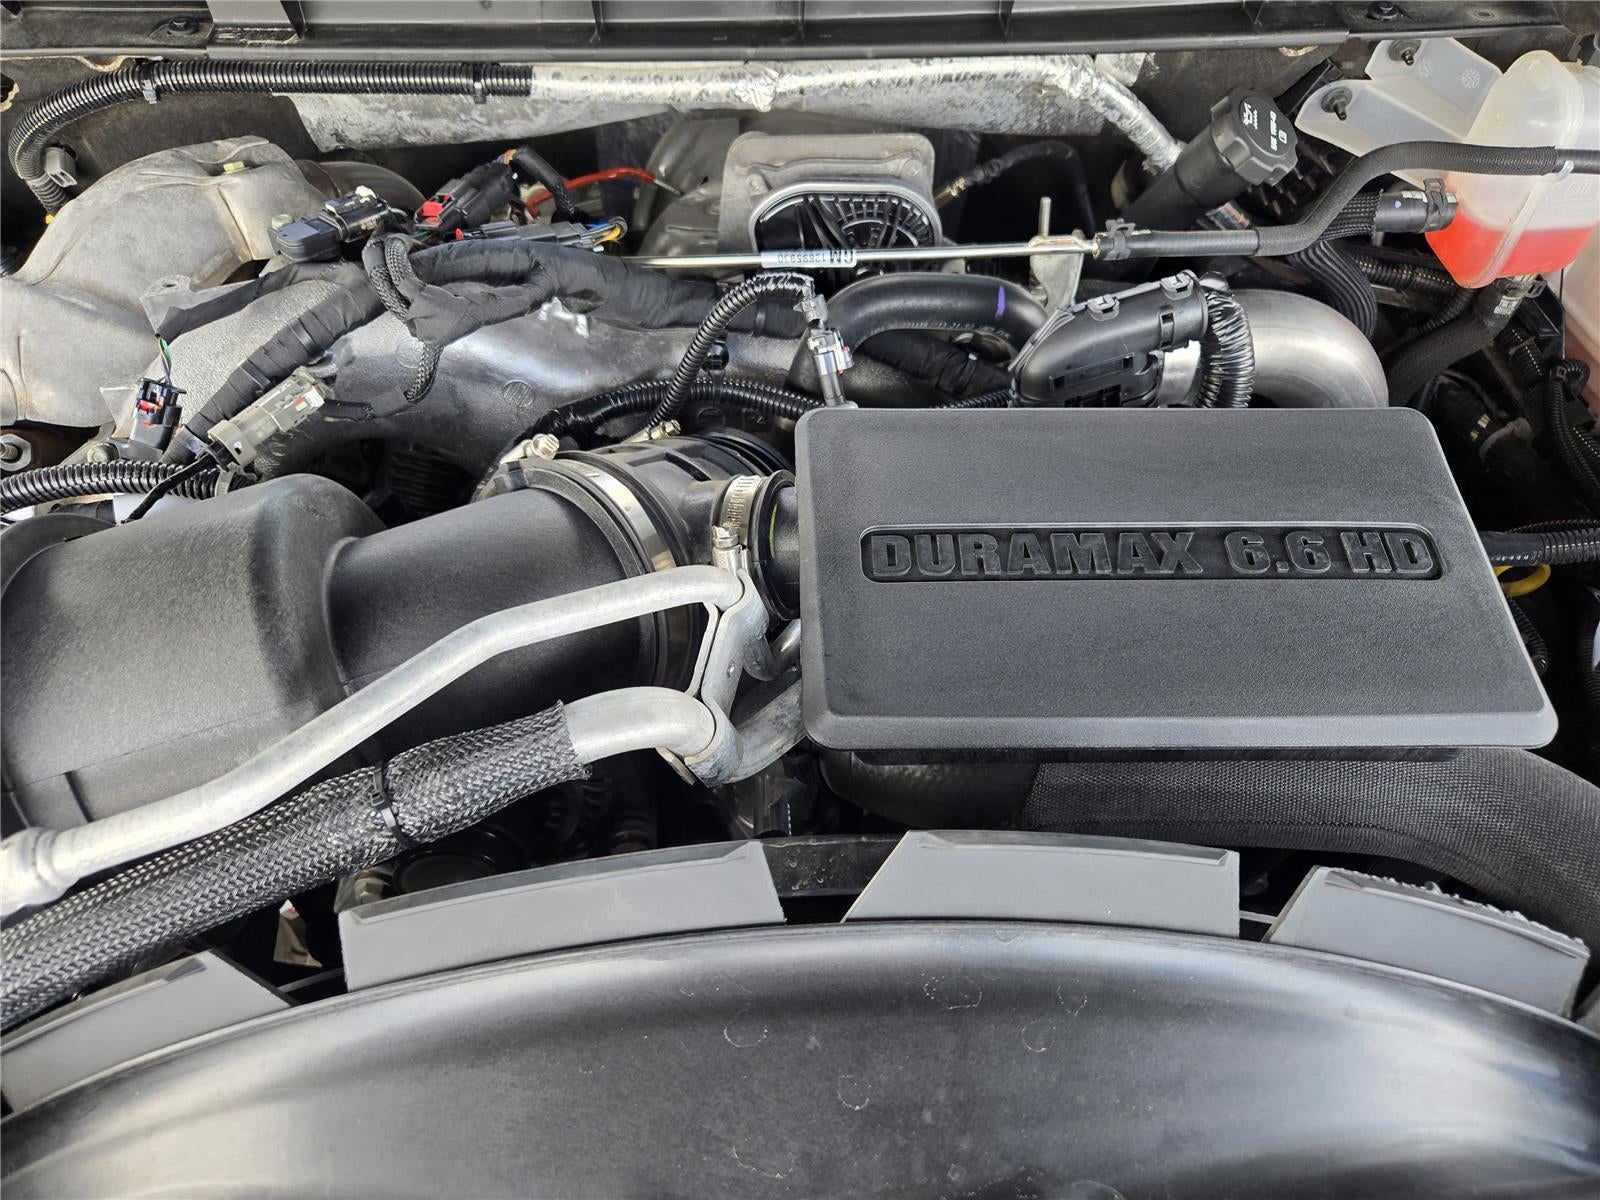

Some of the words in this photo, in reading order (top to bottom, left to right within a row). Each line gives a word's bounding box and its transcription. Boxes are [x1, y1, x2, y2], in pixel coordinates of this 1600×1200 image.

[830, 249, 854, 264] GM
[871, 532, 1203, 576] DURAMAX
[1224, 531, 1331, 574] 6.6
[1340, 531, 1434, 573] HD
